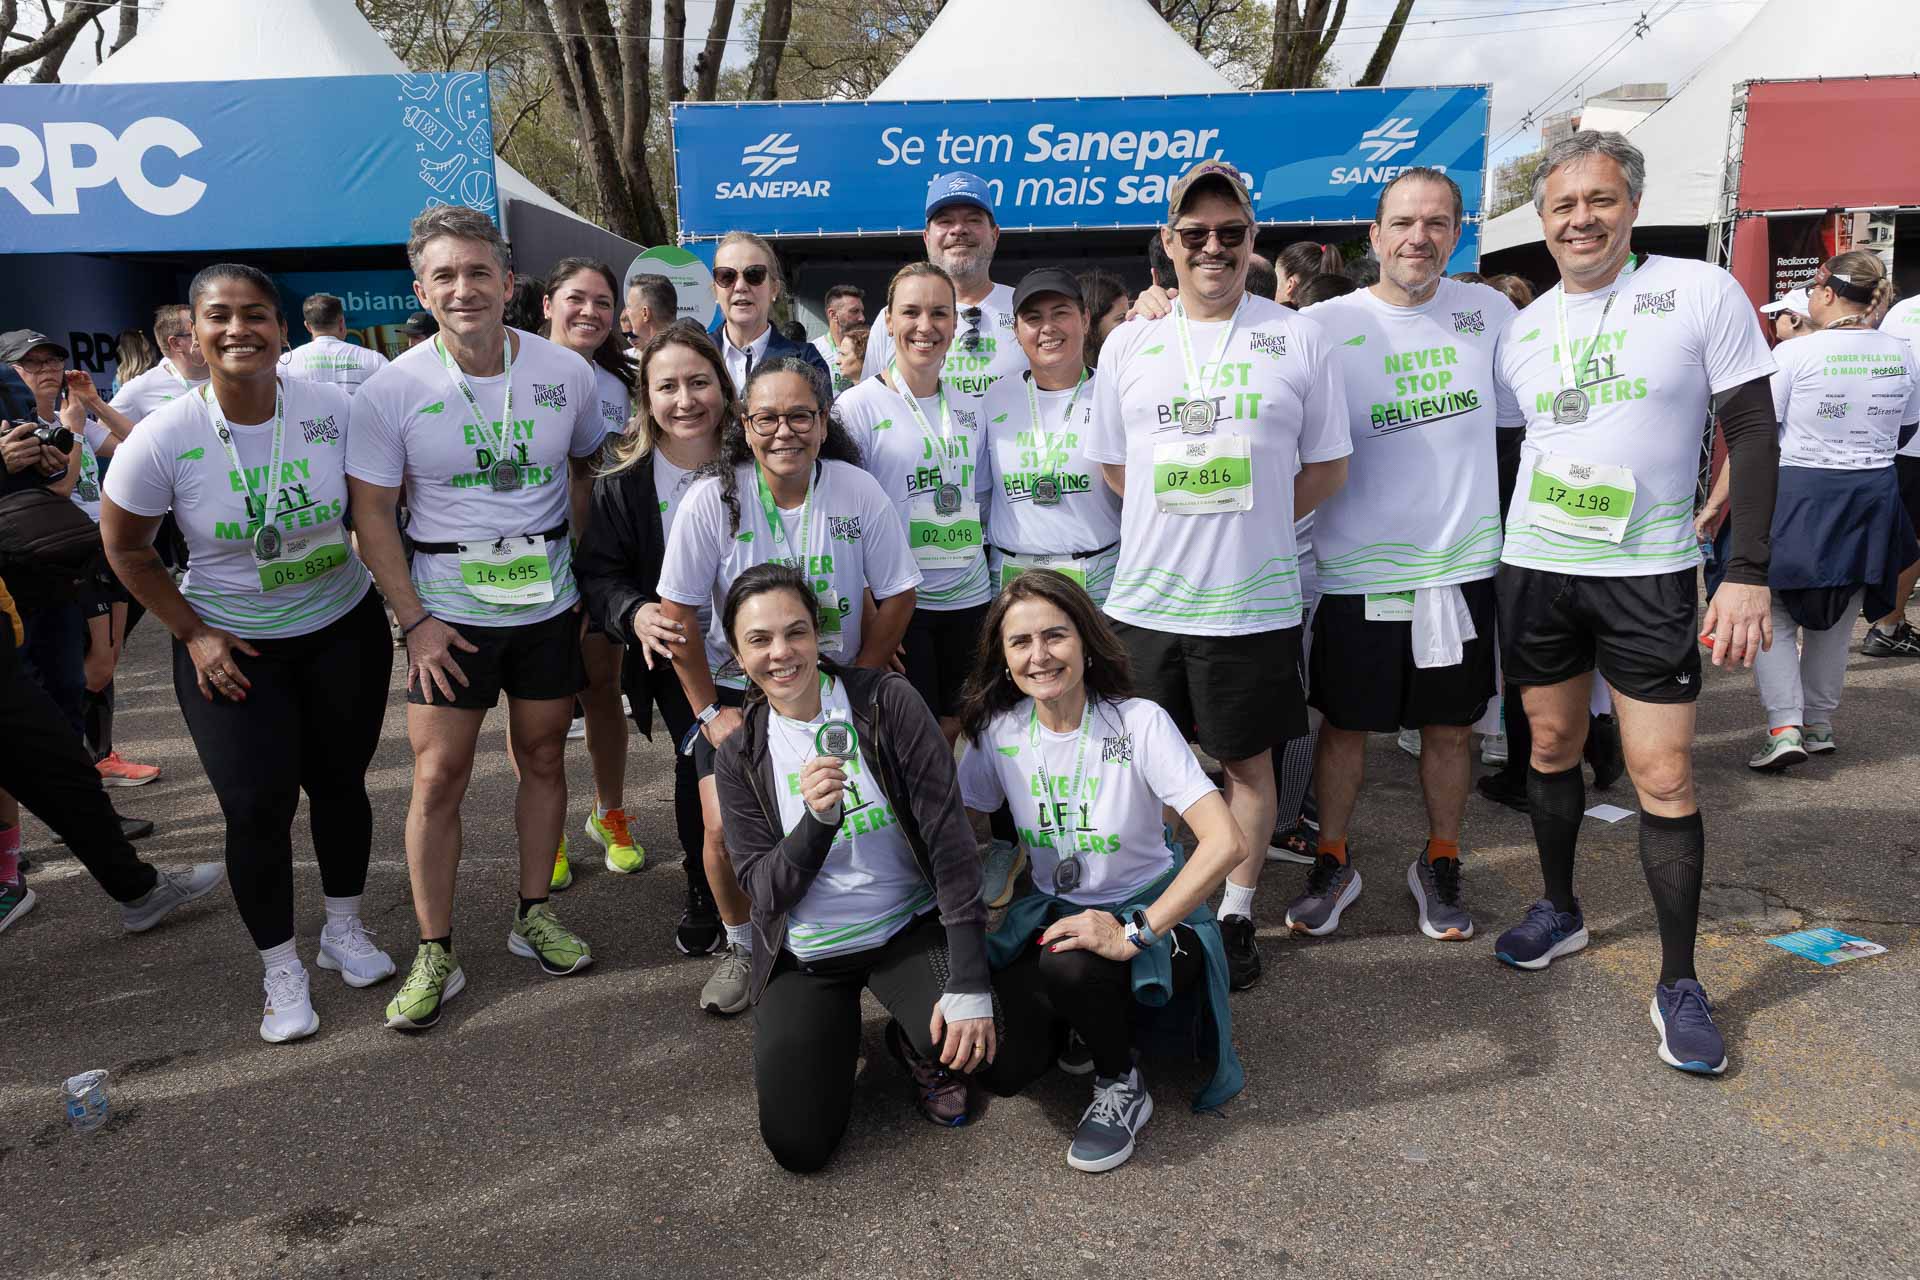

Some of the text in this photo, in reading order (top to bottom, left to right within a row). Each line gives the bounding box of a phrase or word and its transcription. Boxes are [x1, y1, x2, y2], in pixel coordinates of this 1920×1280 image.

[877, 123, 1225, 170] Se tem Sanepar,
[0, 116, 207, 216] RPC
[715, 180, 831, 199] SANEPAR
[1015, 165, 1107, 206] mais
[1777, 256, 1820, 266] Realizar os
[1776, 270, 1794, 278] seus
[1775, 280, 1787, 289] de
[1634, 288, 1677, 315] HARDEST
[1636, 293, 1652, 302] THE
[1652, 300, 1675, 314] RUN
[1452, 312, 1465, 322] THE
[1454, 310, 1482, 333] HARDEST
[1469, 320, 1485, 333] RUN
[1250, 335, 1286, 351] HARDEST
[1251, 332, 1265, 341] THE
[69, 331, 121, 373] RP
[1267, 345, 1286, 356] RUN
[945, 355, 991, 372] STOP
[1384, 346, 1458, 375] NEVER
[1831, 367, 1838, 376] O
[1840, 367, 1868, 375] MAIOR
[533, 383, 547, 394] THE
[1394, 370, 1454, 397] STOP
[535, 384, 565, 406] HARDEST
[550, 394, 568, 408] RUN
[1536, 377, 1648, 414] MTERS
[1235, 392, 1263, 420] IT
[300, 419, 316, 431] THE
[303, 415, 336, 444] HARDEST
[1168, 469, 1232, 487] 07.816
[1546, 486, 1611, 512] 17.198
[214, 498, 342, 541] MATERS
[828, 516, 842, 527] THE
[829, 516, 861, 538] HARDEST
[844, 526, 862, 540] RUN
[922, 529, 973, 543] 02.048
[275, 555, 337, 586] 06.831
[477, 564, 538, 584] 16.695
[1103, 736, 1118, 749] THE
[1017, 826, 1122, 855] MAERS
